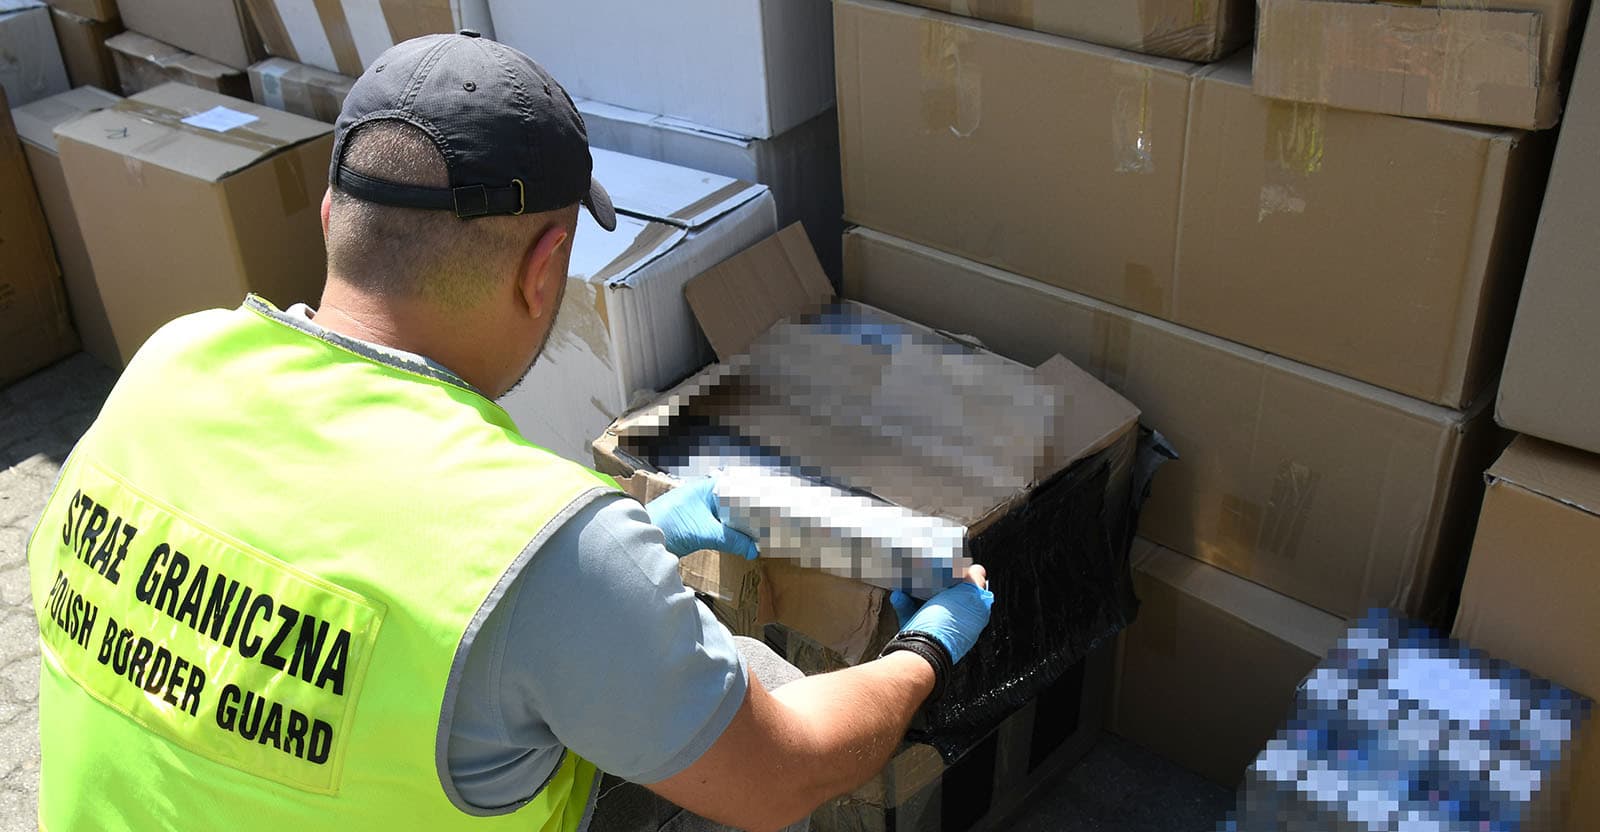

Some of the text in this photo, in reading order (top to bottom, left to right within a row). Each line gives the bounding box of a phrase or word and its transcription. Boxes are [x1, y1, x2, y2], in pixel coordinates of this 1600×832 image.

[44, 570, 333, 765] POLISH BORDER GUARD
[135, 542, 351, 696] GRANICZNA
